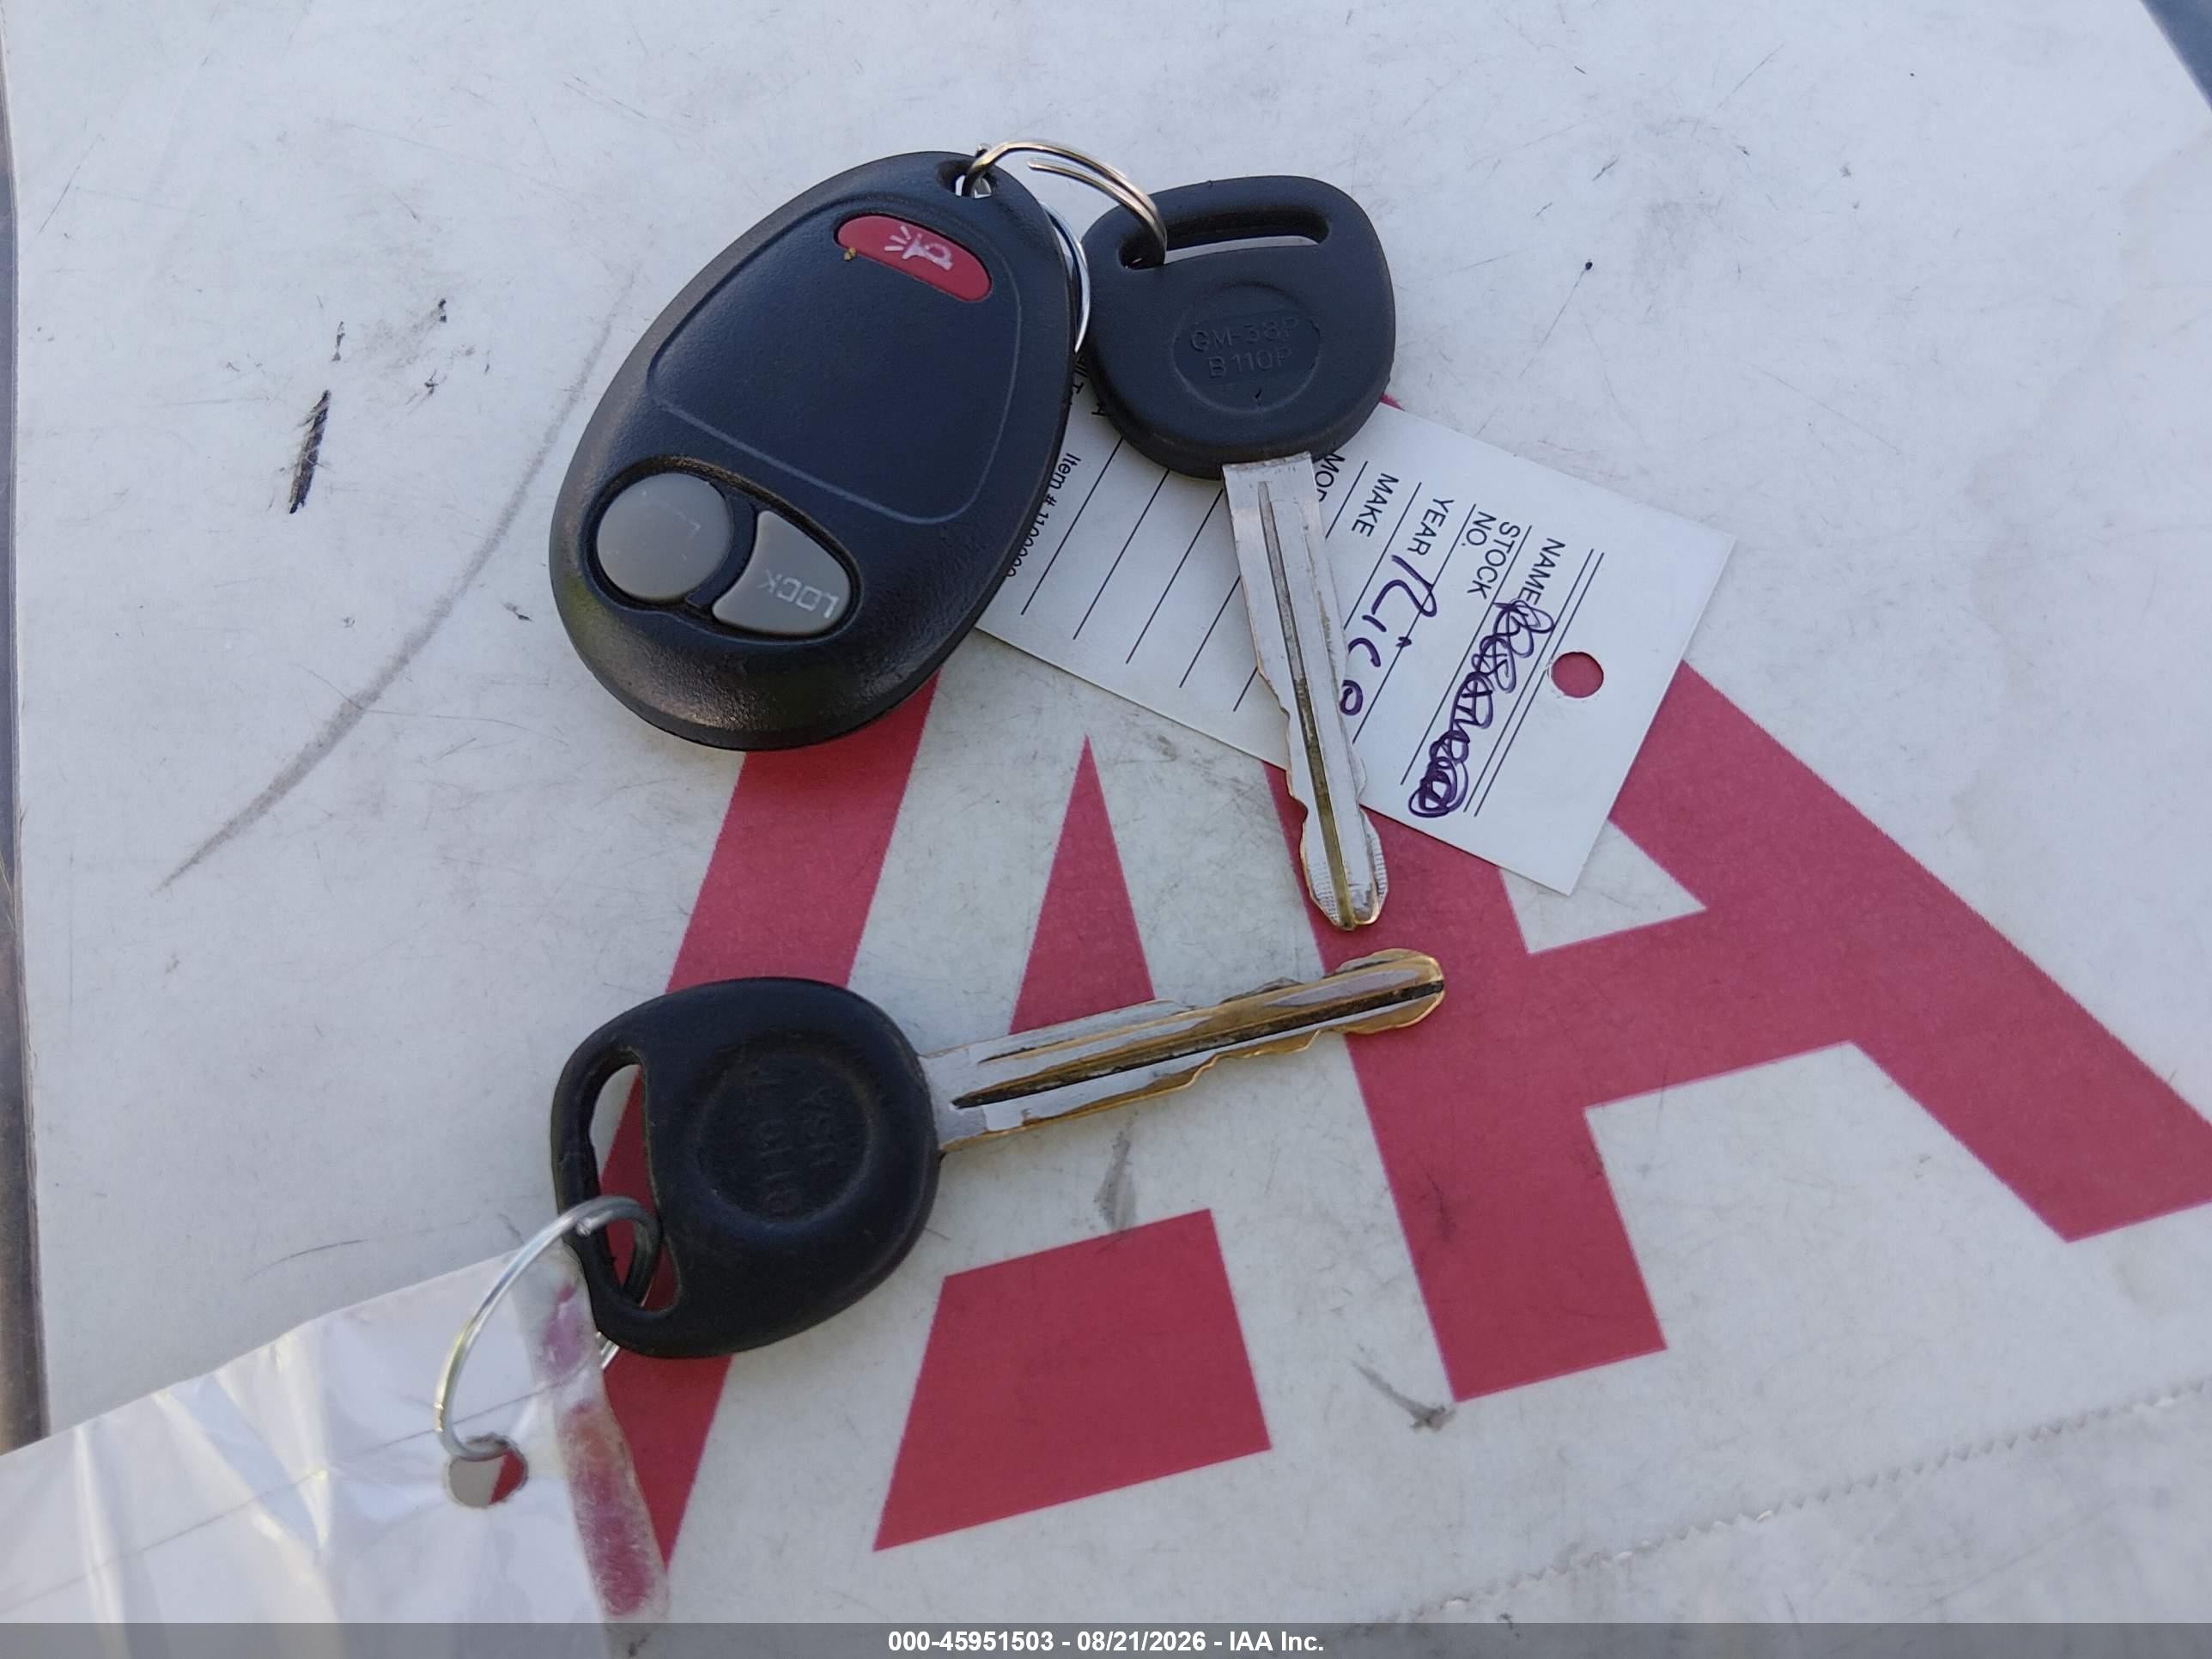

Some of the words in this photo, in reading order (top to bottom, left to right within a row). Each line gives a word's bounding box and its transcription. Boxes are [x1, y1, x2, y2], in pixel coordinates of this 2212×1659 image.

[1351, 472, 1400, 538] MAKE
[1407, 496, 1455, 556] YEAR
[1461, 510, 1498, 547] NO.
[1467, 520, 1521, 600] STOCK
[1518, 538, 1566, 606] NAME
[757, 568, 840, 619] LOCK
